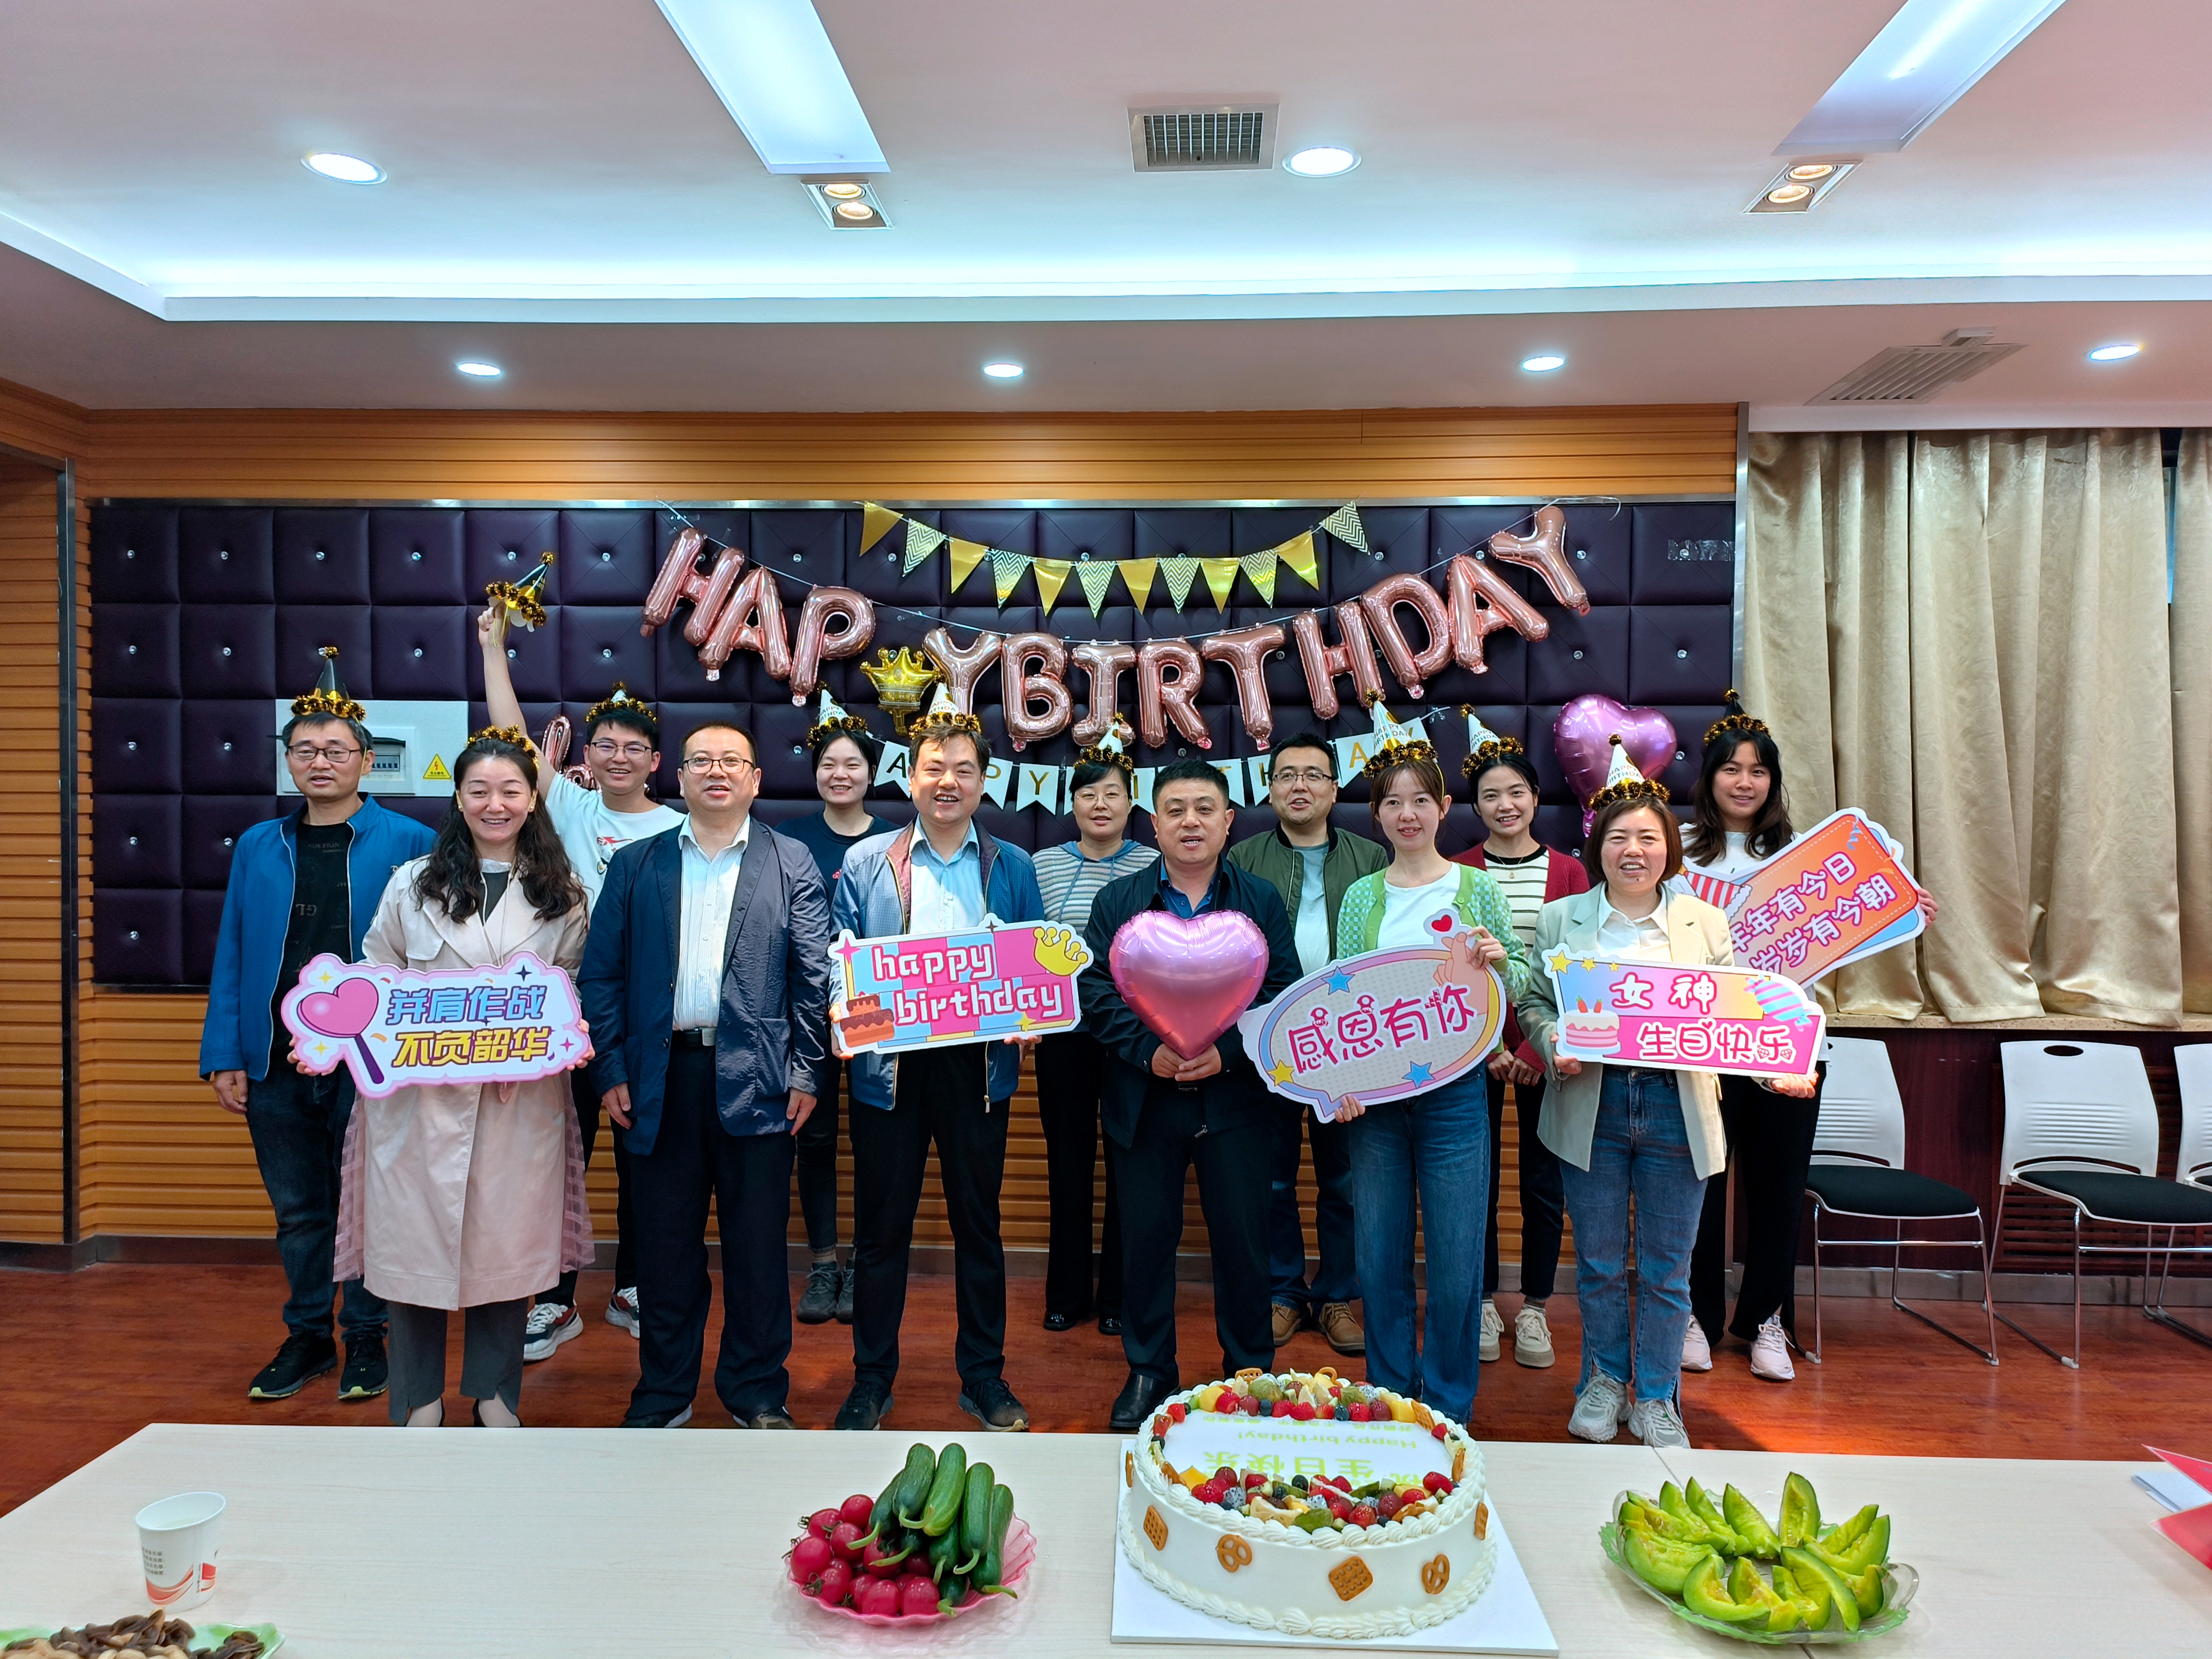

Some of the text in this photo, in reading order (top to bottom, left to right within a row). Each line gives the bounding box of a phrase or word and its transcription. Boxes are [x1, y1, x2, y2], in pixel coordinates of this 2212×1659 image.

[1730, 852, 1856, 952] 年年有今日
[1750, 874, 1897, 973] 岁岁有今朝
[872, 945, 993, 984] happy
[386, 986, 546, 1025] 并肩作战
[896, 980, 1063, 1024] birthday
[1609, 972, 1717, 1014] 女神
[392, 1027, 552, 1067] 不负韶华
[1289, 986, 1477, 1073] 感恩有你
[1638, 1022, 1794, 1062] 生日快乐
[1238, 1431, 1416, 1448] Happy birthday!
